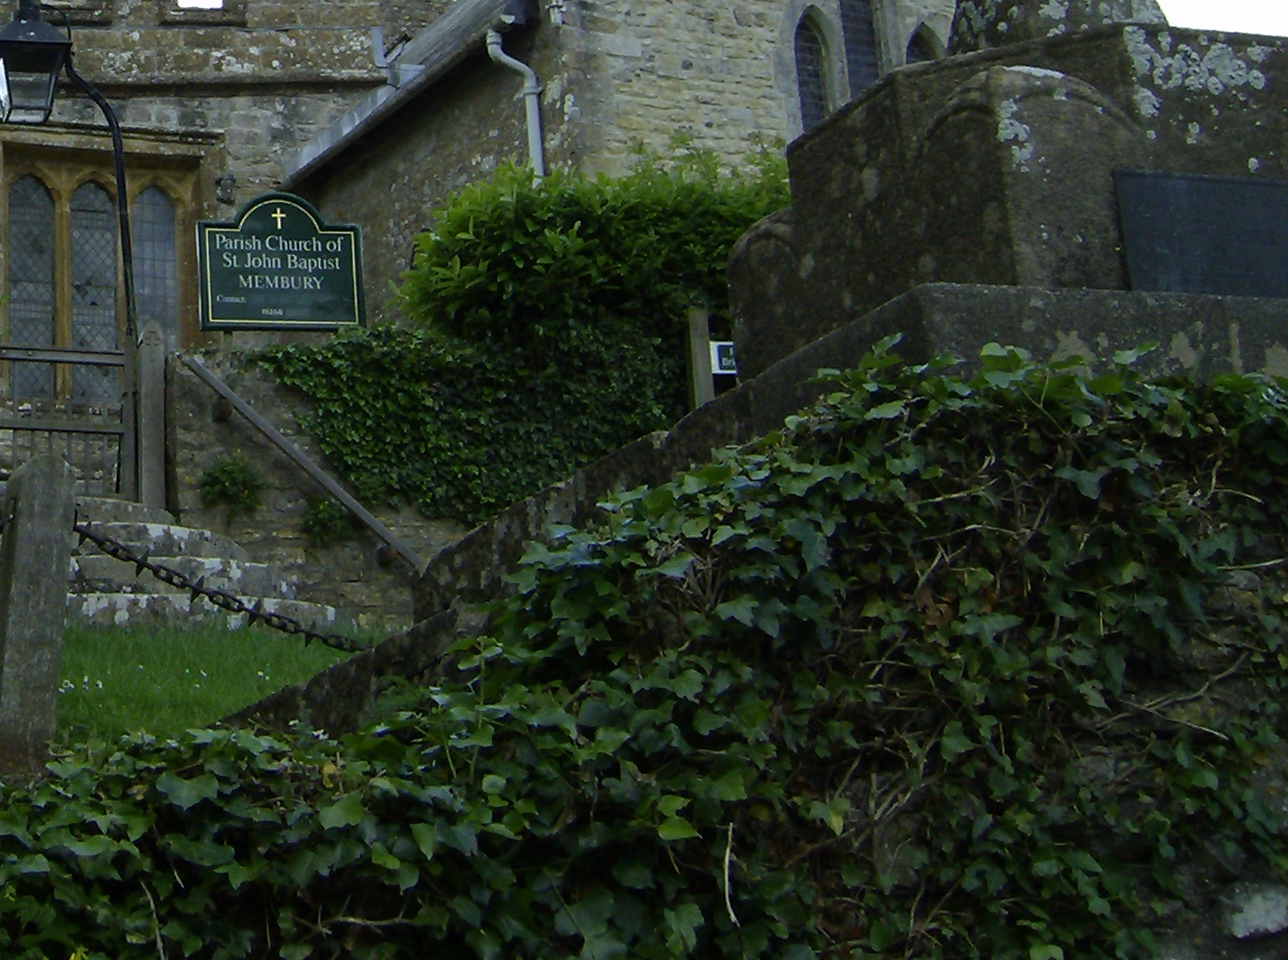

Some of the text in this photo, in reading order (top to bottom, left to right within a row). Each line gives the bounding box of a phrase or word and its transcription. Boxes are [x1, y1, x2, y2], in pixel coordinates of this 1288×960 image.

[215, 233, 344, 253] Parish Church of
[244, 252, 282, 269] John
[286, 253, 341, 273] Baptist
[238, 274, 325, 290] MEMBURY
